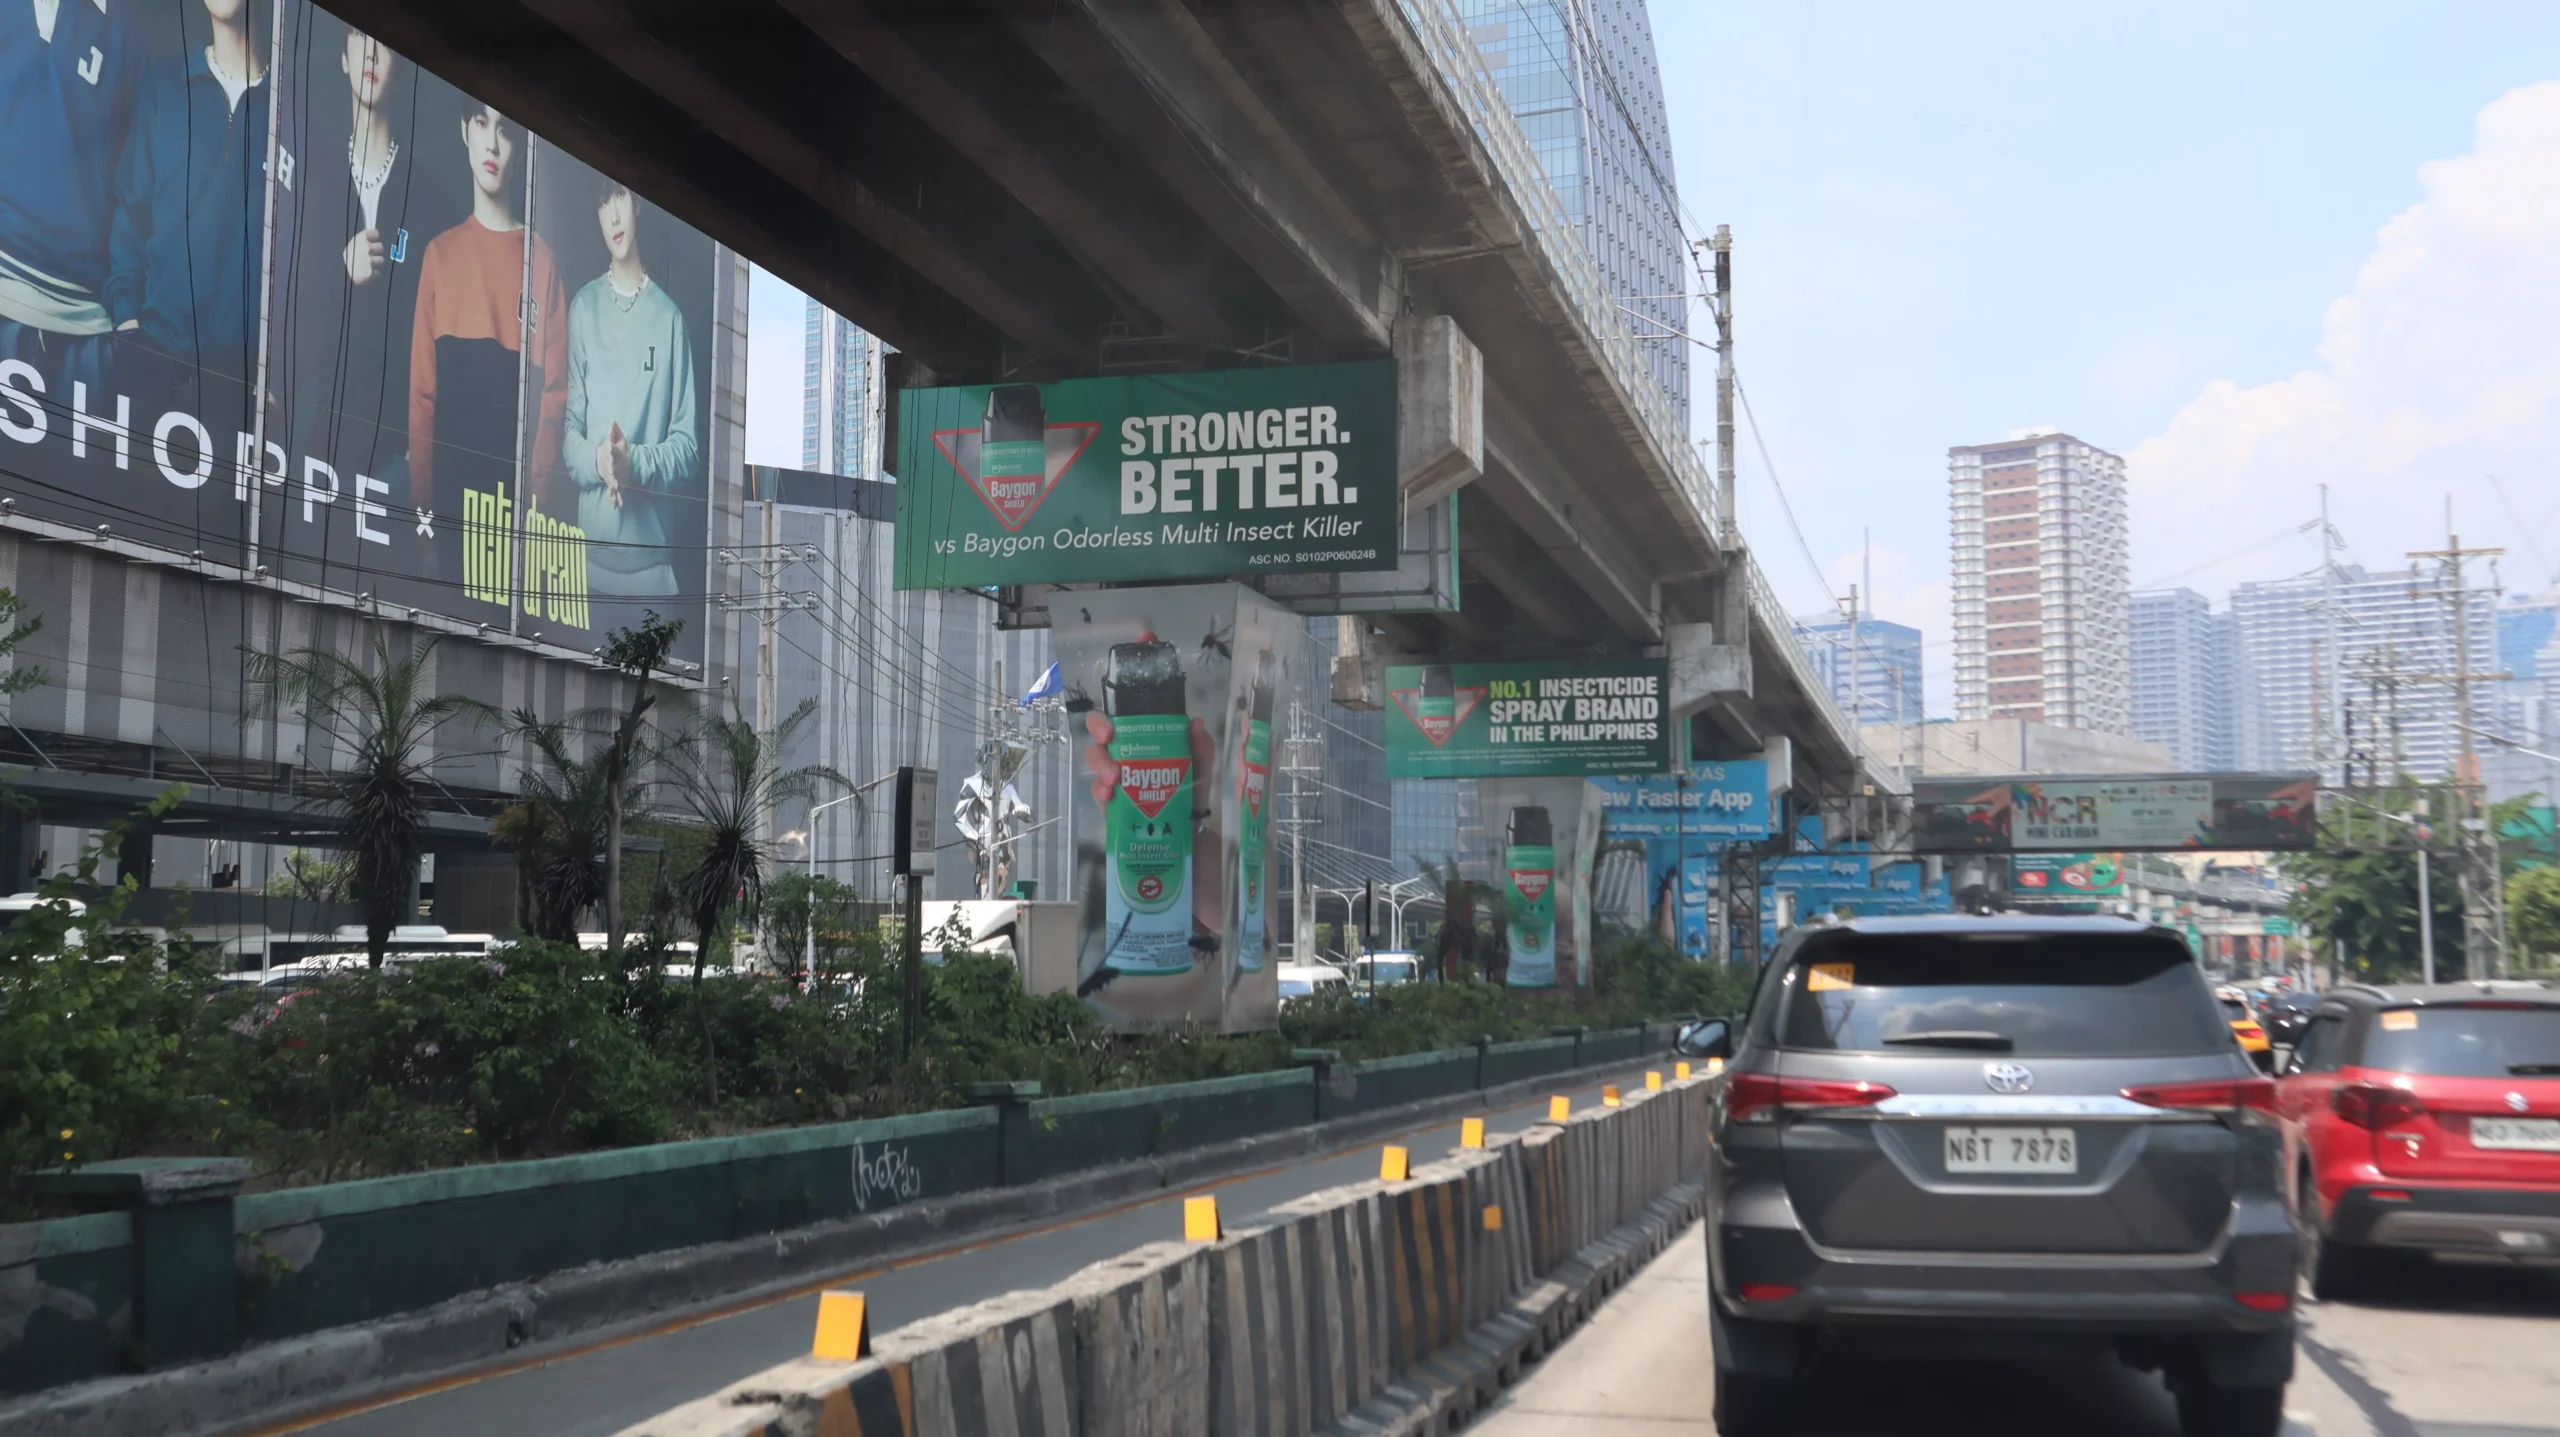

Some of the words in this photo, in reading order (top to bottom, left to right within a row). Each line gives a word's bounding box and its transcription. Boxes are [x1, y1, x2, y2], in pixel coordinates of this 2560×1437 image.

[77, 45, 104, 85] J
[390, 227, 408, 263] J
[643, 345, 655, 372] J
[1120, 405, 1351, 456] STRONGER.
[991, 480, 1036, 499] Baygon
[1120, 450, 1358, 515] BETTER.
[1004, 499, 1025, 508] SHIELD
[934, 539, 956, 554] vs
[963, 532, 1045, 558] Baygon
[1053, 525, 1154, 549] Odorless
[1161, 522, 1220, 545] Multi
[1226, 520, 1295, 542] Insect
[1302, 515, 1362, 538] Killer
[523, 493, 591, 631] dream
[1249, 555, 1271, 565] ASC
[1273, 553, 1293, 563] NO.
[1295, 549, 1377, 563] S0102P060624B
[1490, 680, 1532, 698] NO.1
[1539, 677, 1658, 697] INSECTICIDE
[1489, 699, 1567, 723] SPRAY
[1575, 697, 1659, 721] BRAND
[1489, 727, 1508, 743] IN
[1512, 725, 1545, 742] THE
[1549, 723, 1658, 741] PHILIPPINES
[1121, 766, 1180, 788] Baygon
[1139, 790, 1166, 801] SHIELD
[1603, 791, 1631, 807] ew
[1637, 788, 1704, 807] Faster
[1707, 787, 1754, 812] App
[2026, 795, 2099, 825] NCR
[1130, 842, 1171, 852] Defense
[1949, 1138, 1993, 1162] NBT
[2010, 1138, 2073, 1163] 7878
